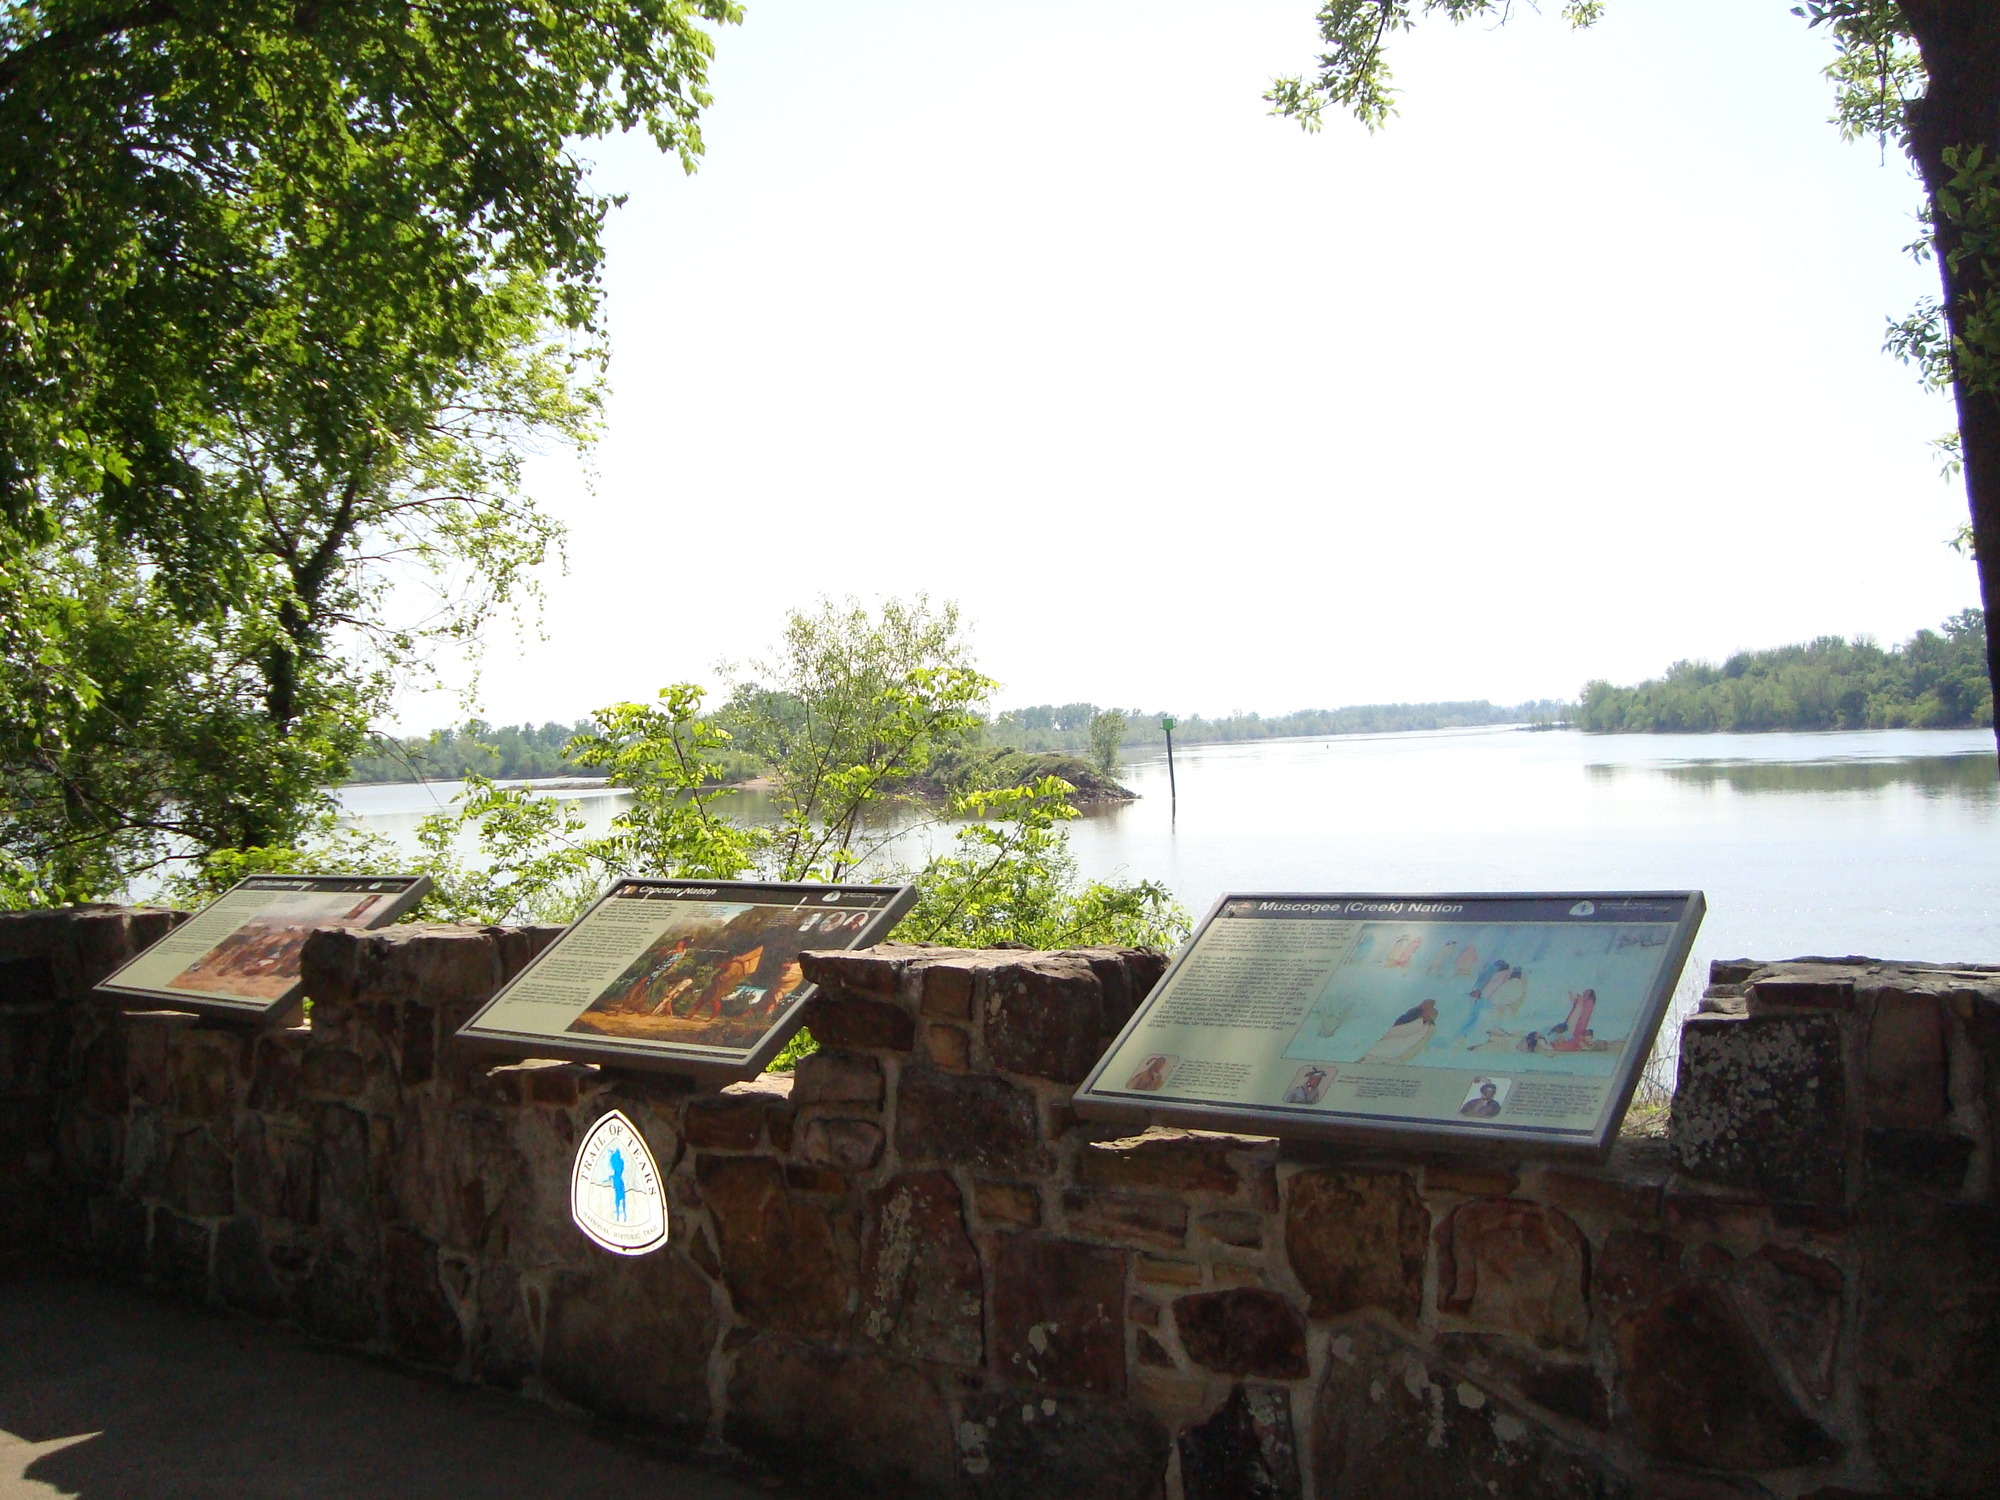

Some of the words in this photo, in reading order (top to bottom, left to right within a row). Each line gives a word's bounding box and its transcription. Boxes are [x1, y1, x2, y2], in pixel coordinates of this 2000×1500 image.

[639, 885, 684, 895] Choctaw
[684, 886, 718, 896] Nation
[1258, 901, 1341, 914] Muscogee
[1343, 901, 1404, 914] (Creek)
[1407, 902, 1464, 913] Nation
[581, 1137, 605, 1180] TRAIL
[609, 1124, 623, 1136] OF
[628, 1136, 657, 1195] TEARS
